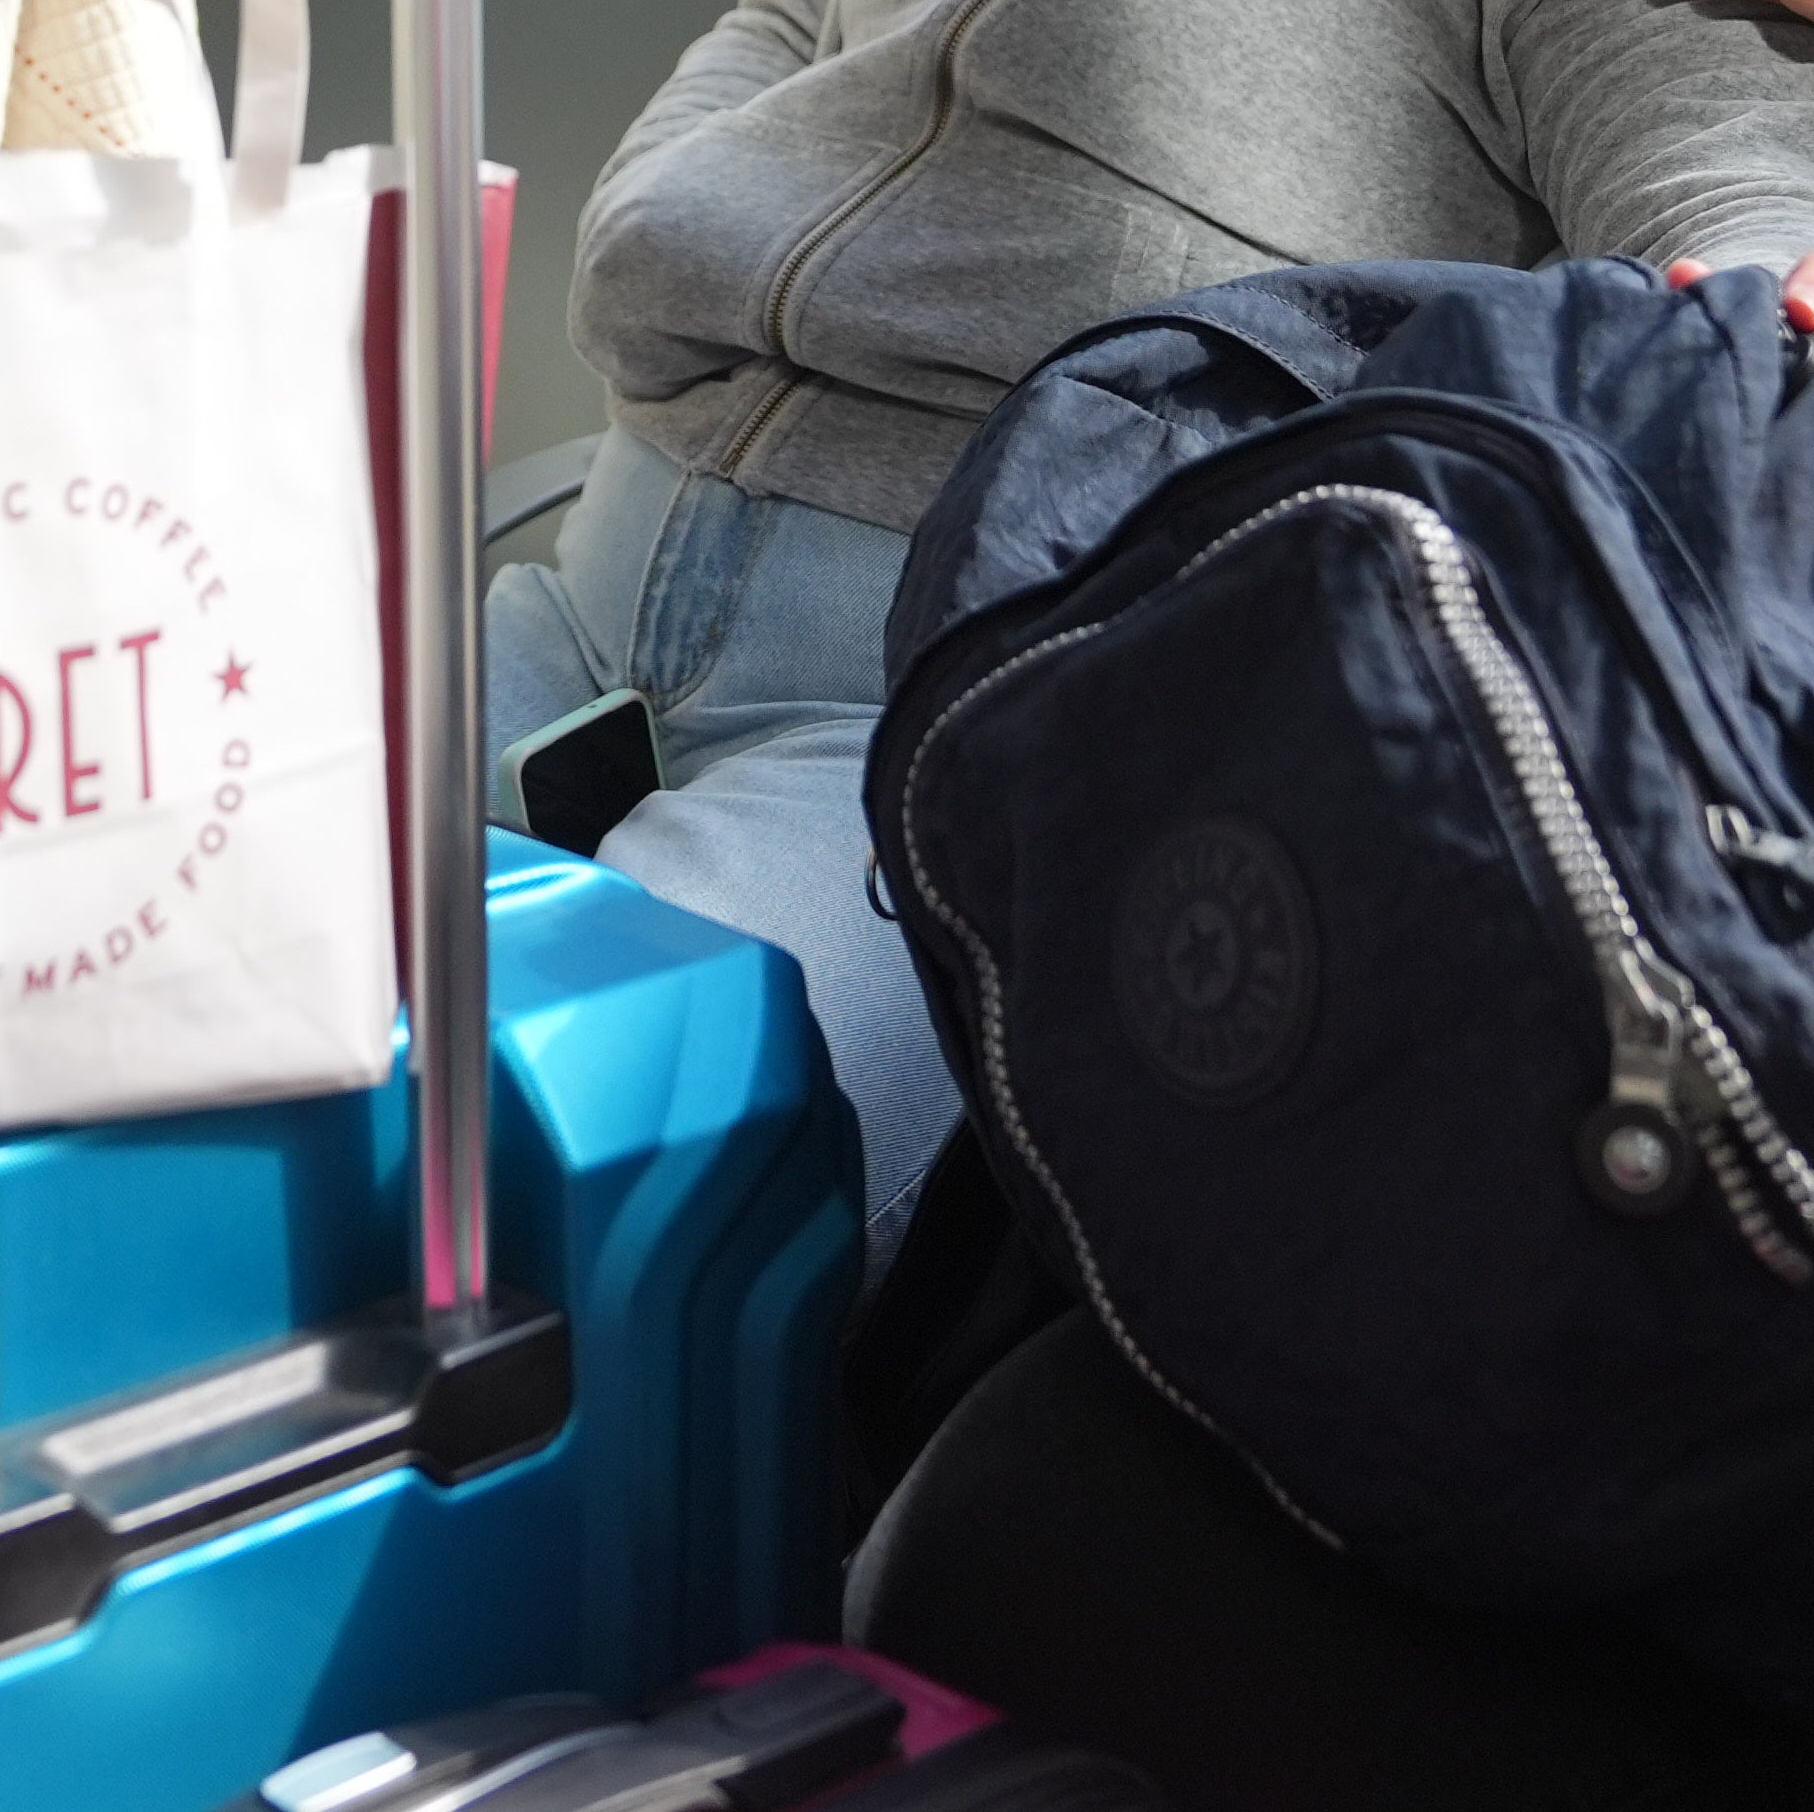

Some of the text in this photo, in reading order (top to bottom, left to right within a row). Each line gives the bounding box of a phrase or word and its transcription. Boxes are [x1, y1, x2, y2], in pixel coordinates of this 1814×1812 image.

[63, 476, 227, 615] COFFEE
[22, 738, 251, 997] MADE FOOD
